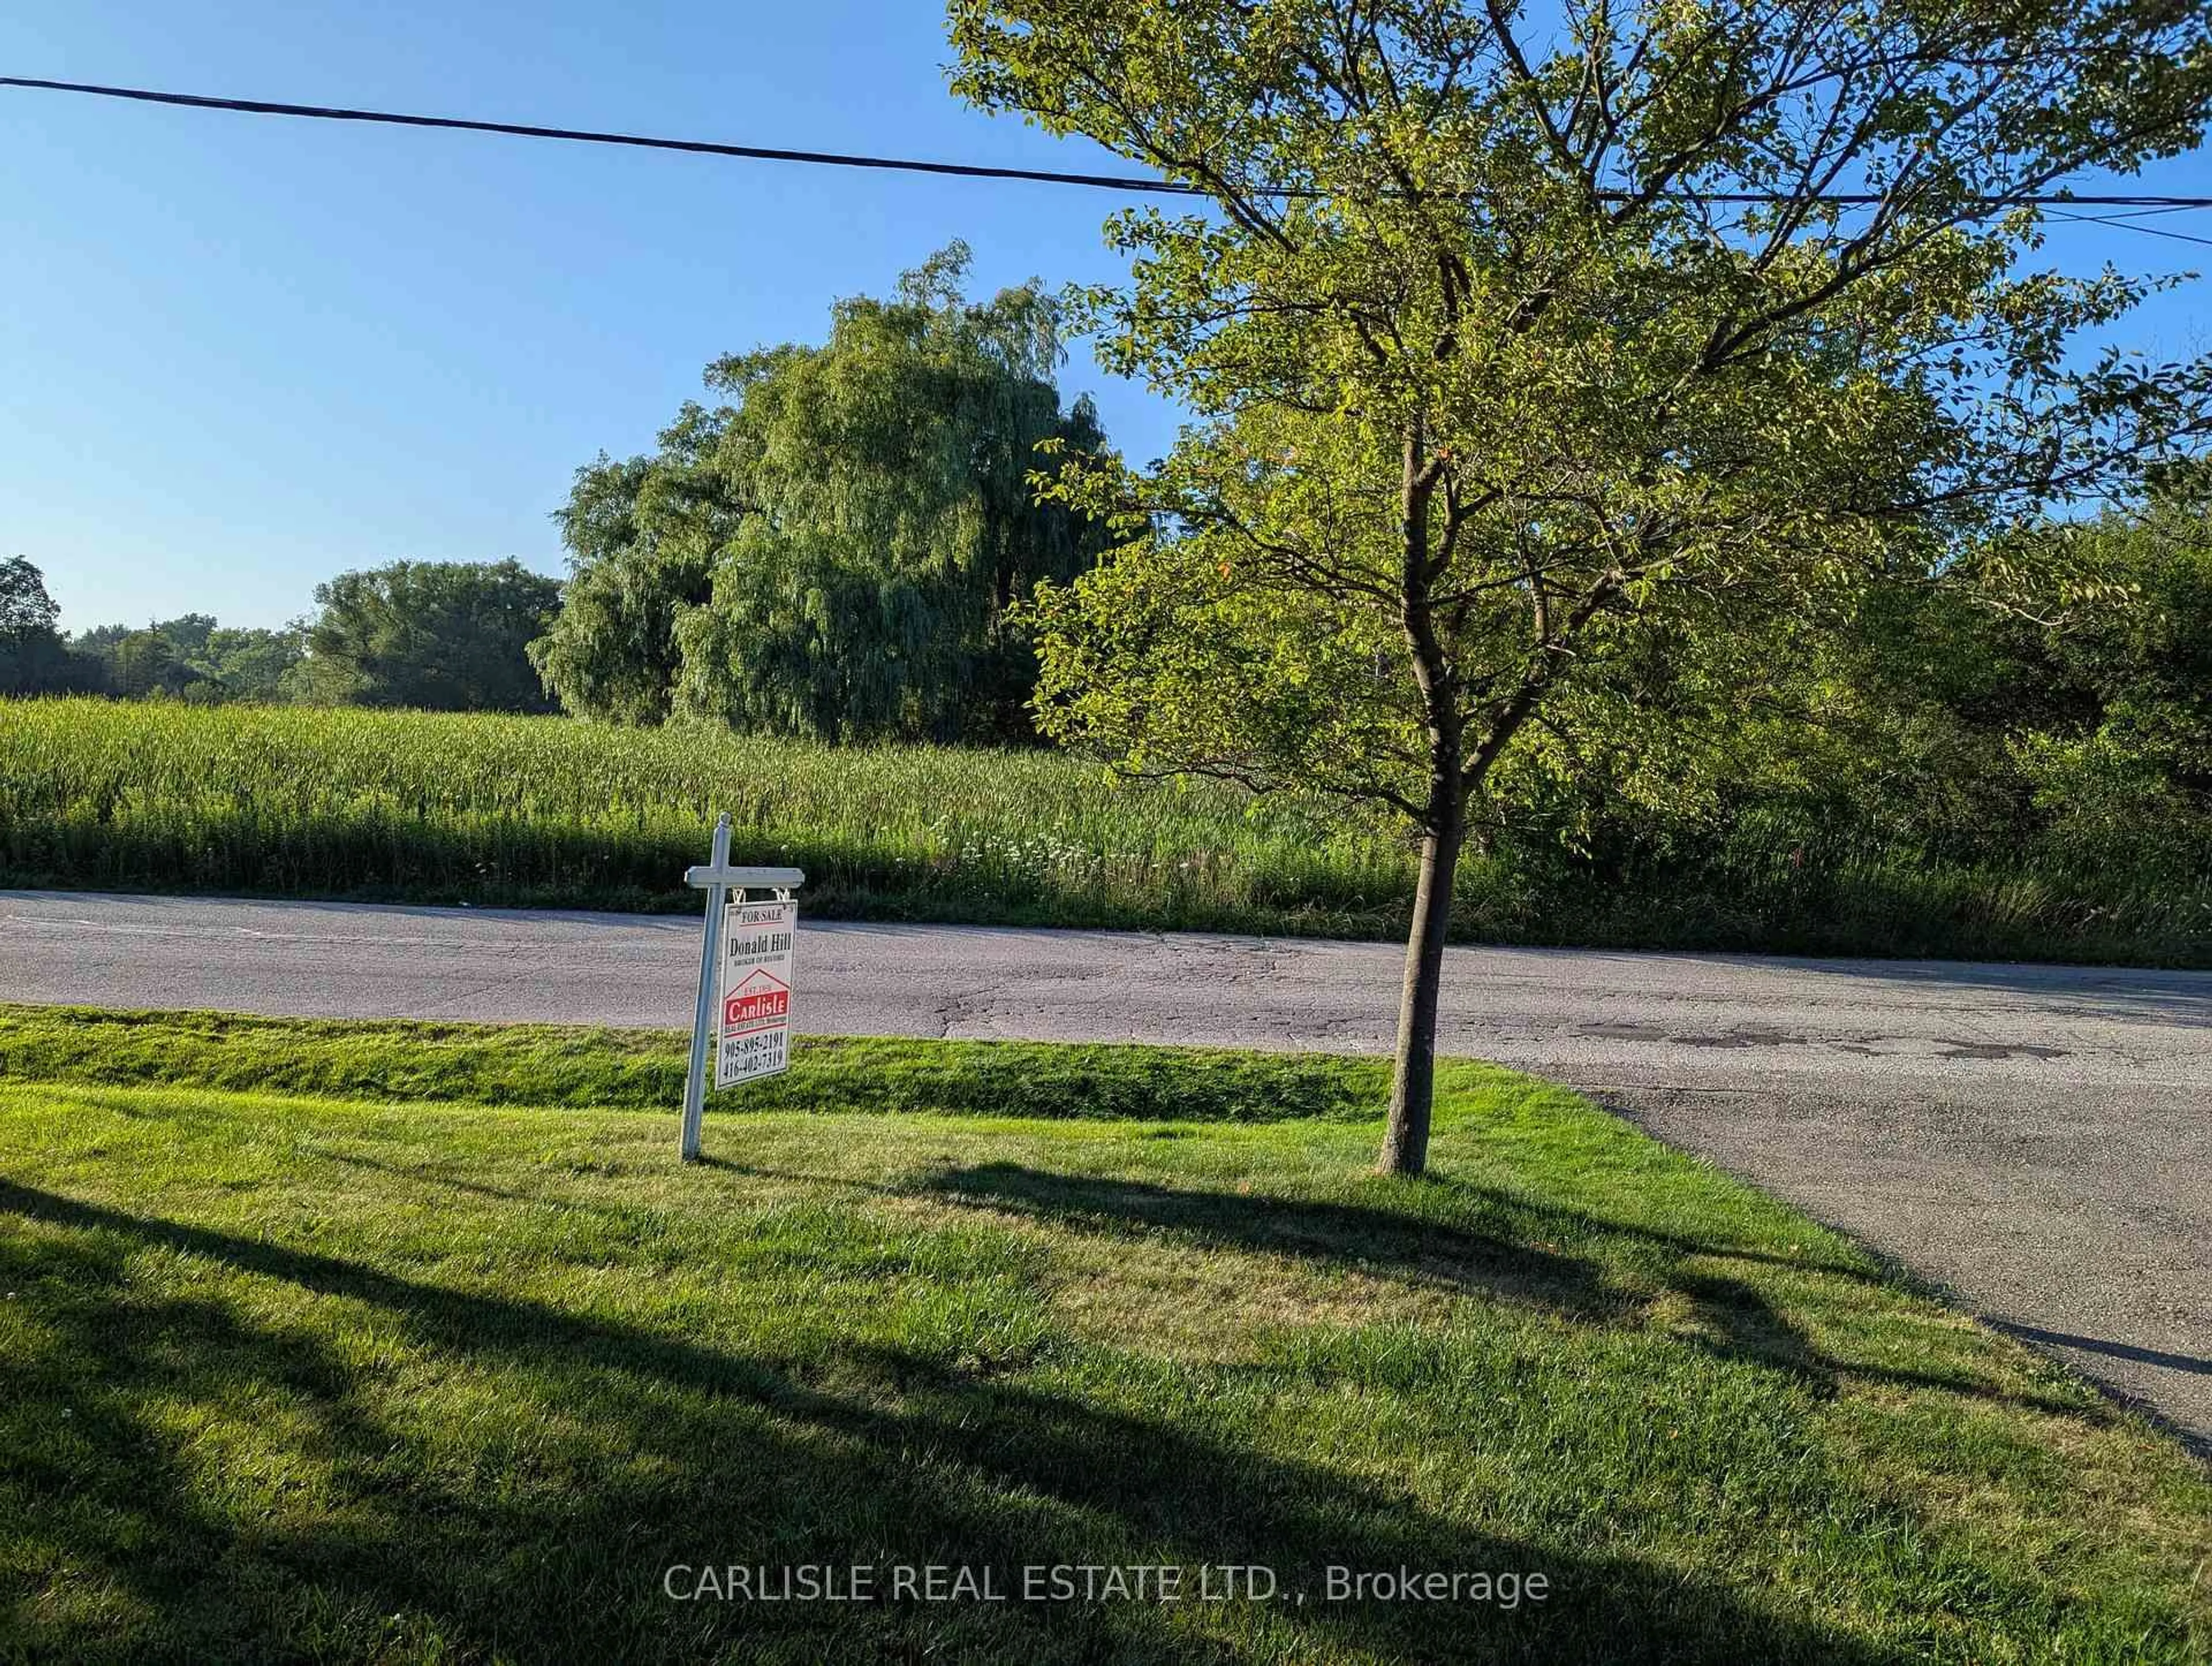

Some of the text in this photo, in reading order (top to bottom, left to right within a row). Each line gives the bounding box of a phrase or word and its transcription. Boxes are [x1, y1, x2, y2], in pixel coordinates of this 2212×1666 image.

[741, 910, 782, 923] FOR SALE
[730, 933, 791, 957] Donald Hill
[725, 1032, 783, 1060] 905-895-2191
[724, 1049, 783, 1078] 416-402-7319
